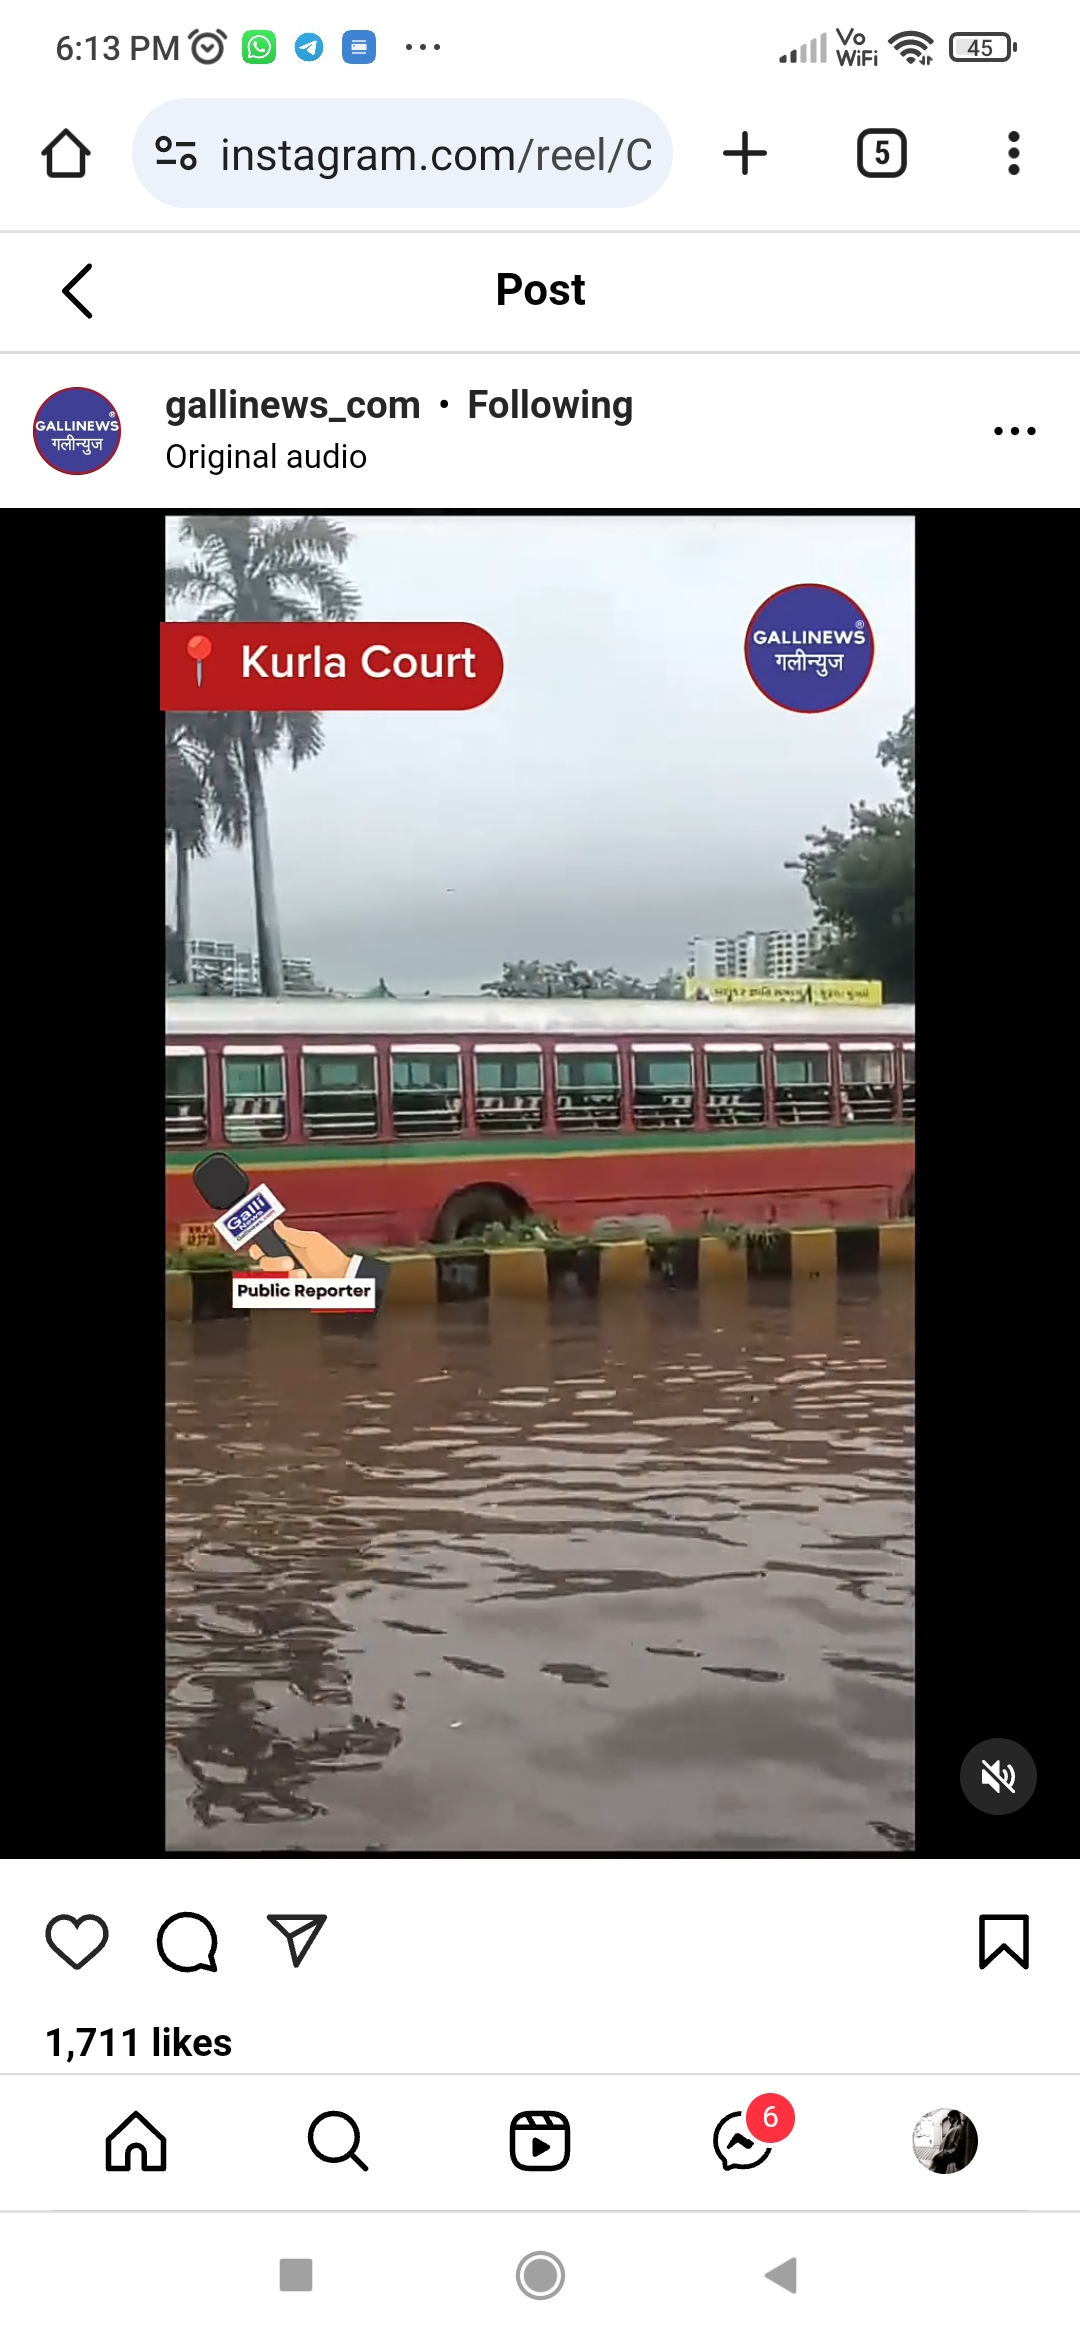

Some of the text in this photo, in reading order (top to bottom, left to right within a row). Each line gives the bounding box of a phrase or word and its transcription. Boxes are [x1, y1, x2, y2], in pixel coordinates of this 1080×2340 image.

[56, 34, 179, 61] 6:13 PM
[835, 27, 866, 46] Vo
[967, 39, 993, 57] 45
[835, 49, 878, 67] WiFi
[221, 136, 653, 180] instagram.com/reel/C
[874, 139, 890, 165] 5
[497, 272, 586, 306] Post
[165, 388, 633, 425] gallinews_com Following
[35, 420, 120, 432] GALLINEWS
[166, 442, 367, 476] Original audio
[46, 2026, 232, 2063] 1,711 likes
[763, 2105, 779, 2128] 6
